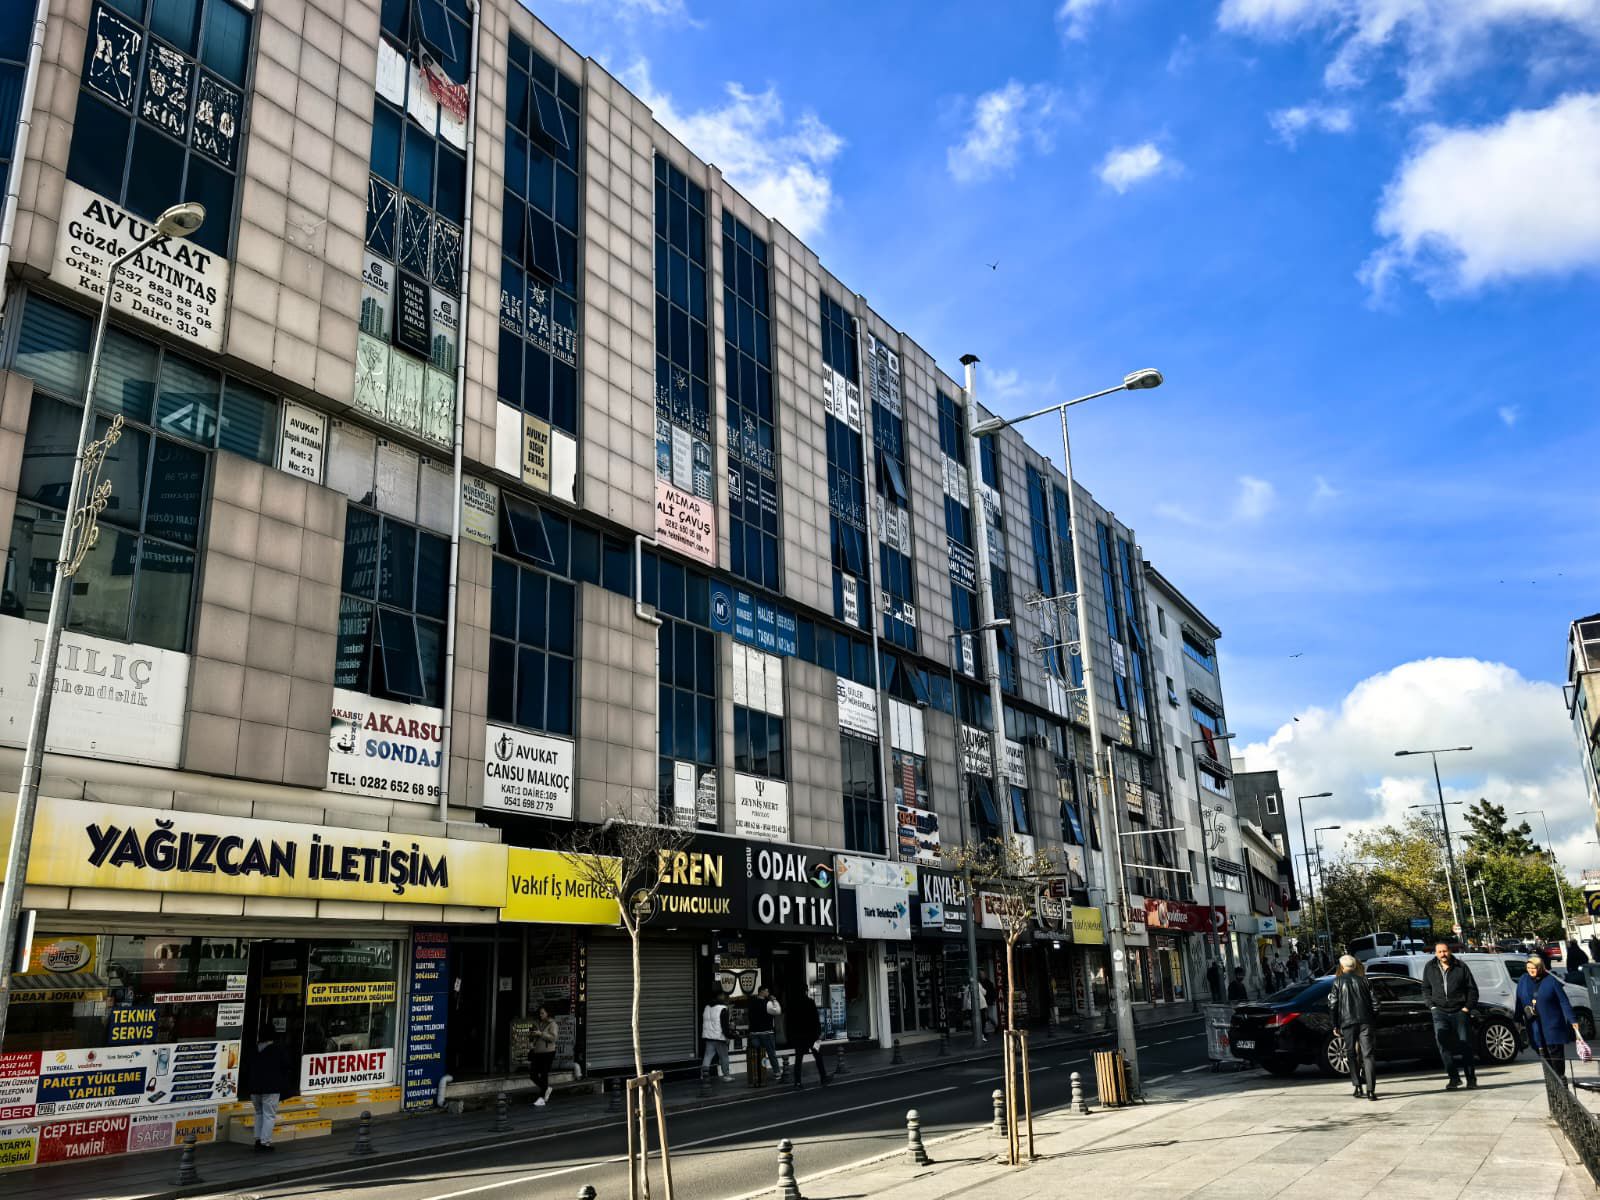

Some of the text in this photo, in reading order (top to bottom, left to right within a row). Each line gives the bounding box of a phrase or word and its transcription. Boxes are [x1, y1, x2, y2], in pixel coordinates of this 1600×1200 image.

[83, 199, 210, 274] AVUKAT
[69, 221, 217, 305] Gözde ALTINTAŞ
[66, 257, 101, 278] Ofis:
[147, 293, 172, 311] 650
[176, 306, 192, 320] 56
[196, 316, 212, 329] 08
[71, 246, 210, 316] Cep: 537 883 88 31
[113, 292, 122, 303] 3
[131, 299, 173, 326] Daire:
[176, 320, 198, 337] 313
[500, 289, 523, 324] AK
[290, 418, 319, 435] AVUKAT
[289, 460, 300, 472] No:
[290, 447, 312, 462] Kat: 2
[666, 490, 700, 515] MİMAR
[657, 501, 711, 535] ALİ ÇAVUŞ
[364, 712, 443, 742] AKARSU
[366, 739, 442, 768] SONDAJ
[516, 745, 558, 765] AVUKAT
[330, 771, 440, 797] TEL: 0282 652 68 96
[487, 762, 569, 793] CANSU MALKOÇ
[85, 818, 449, 895] YAĞIZCAN İLETİŞİM
[758, 850, 808, 884] ODAK
[511, 874, 549, 895] Vakıf
[551, 873, 561, 900] İş
[312, 983, 394, 994] CEP TELEFONU TAMİRİ
[7, 1068, 36, 1077] TAŞIMA
[43, 1071, 141, 1089] PAKET YÜKLEME
[308, 1072, 385, 1087] BAŞVURU NOKTASI
[26, 1086, 34, 1094] VE
[68, 1085, 116, 1099] YAPILIR
[86, 1100, 102, 1109] OYUN
[43, 1117, 127, 1139] CEP TELEFONU
[65, 1137, 105, 1157] TAMİRİ
